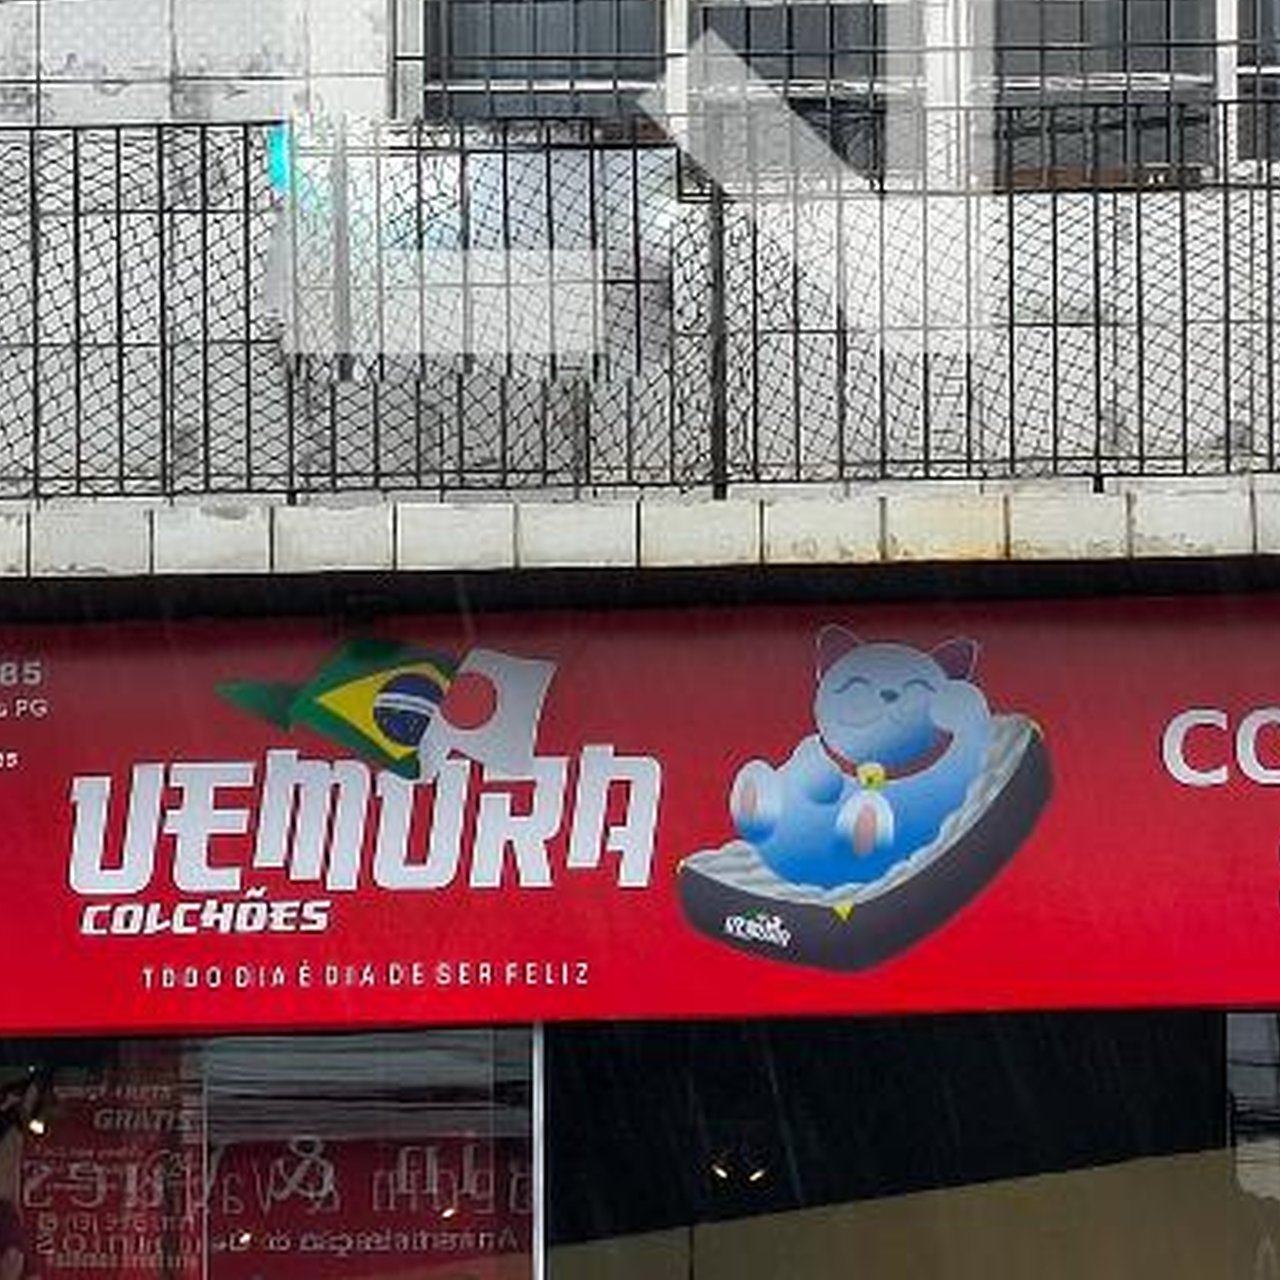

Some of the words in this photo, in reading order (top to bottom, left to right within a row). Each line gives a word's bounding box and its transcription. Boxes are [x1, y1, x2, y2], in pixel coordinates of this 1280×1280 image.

[15, 698, 49, 718] PG
[68, 744, 662, 895] UEMURA
[80, 886, 332, 935] COLCHÕES
[142, 966, 222, 988] TODO
[235, 966, 286, 988] DIA
[298, 960, 314, 988] É
[325, 964, 375, 987] DIA
[388, 962, 425, 986] DE
[436, 962, 492, 986] SER
[505, 961, 589, 986] FELIZ
